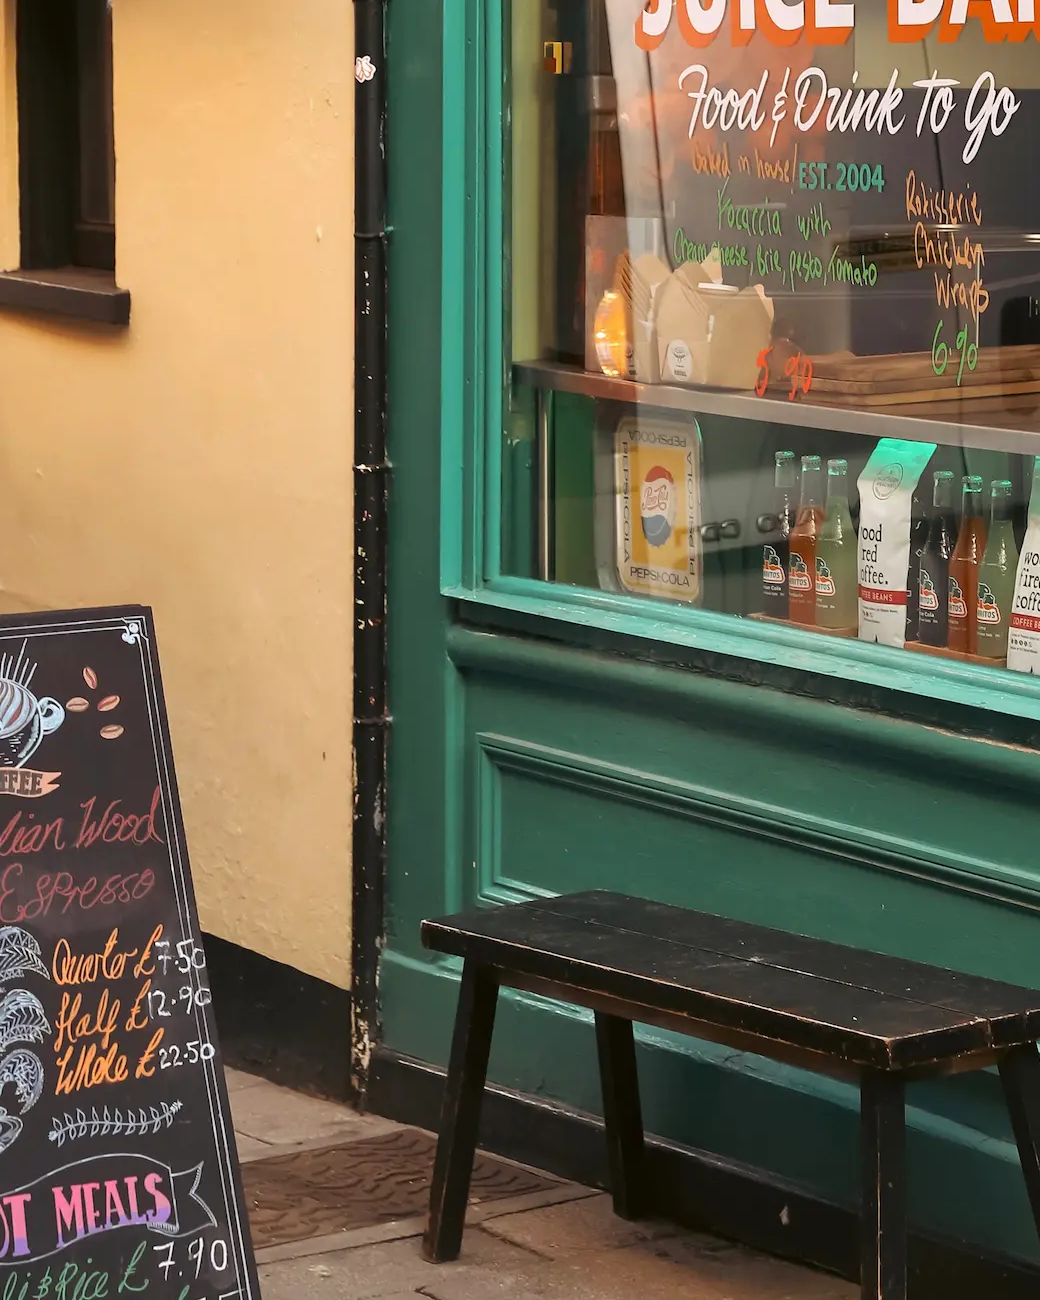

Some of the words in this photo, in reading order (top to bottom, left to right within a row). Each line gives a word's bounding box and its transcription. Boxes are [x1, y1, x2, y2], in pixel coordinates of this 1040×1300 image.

[679, 65, 768, 139] Food
[770, 67, 791, 148] &
[793, 67, 906, 134] Drink
[963, 71, 1021, 164] Go
[738, 155, 751, 176] in
[799, 162, 832, 190] EST.
[836, 162, 885, 193] 2004
[798, 202, 832, 241] with
[905, 169, 982, 226] Rotisserie
[673, 227, 708, 264] Cream
[914, 221, 985, 270] Chicken
[935, 271, 990, 323] Wraps
[872, 591, 893, 602] BEANS
[1013, 617, 1033, 629] COFFEE
[76, 785, 165, 849] Wood
[52, 927, 138, 986] Quarter
[54, 987, 121, 1053] Half
[55, 1042, 129, 1095] Whole
[52, 1172, 172, 1249] MEALS
